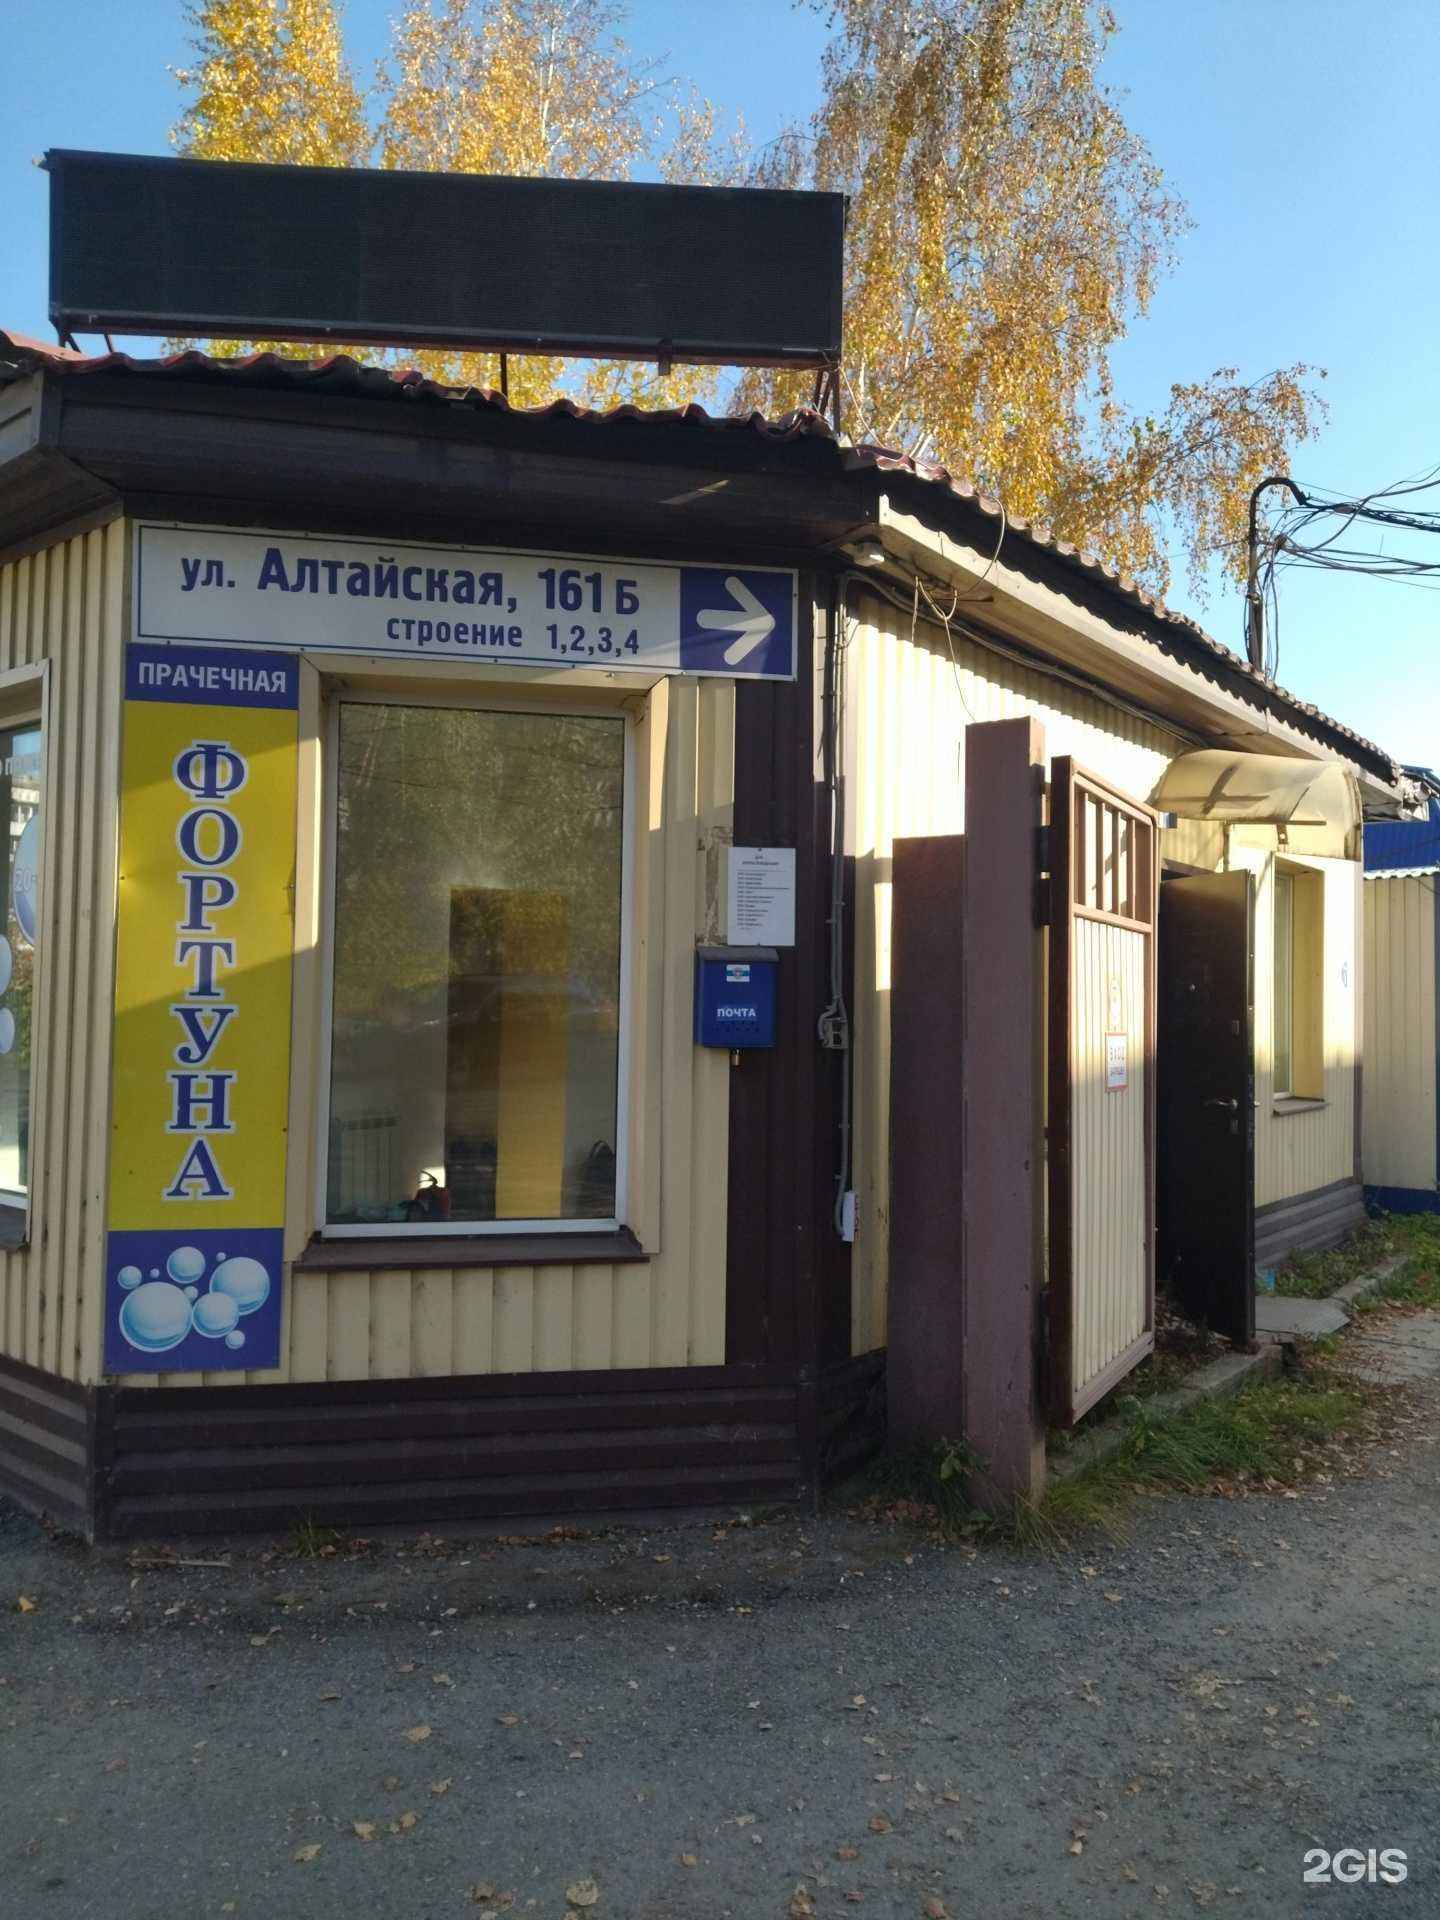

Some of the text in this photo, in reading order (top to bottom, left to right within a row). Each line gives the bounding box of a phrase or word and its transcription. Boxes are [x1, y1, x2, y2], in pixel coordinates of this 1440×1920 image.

[181, 547, 640, 615] ул. Алтайская, 161 Б
[387, 617, 523, 647] строение
[138, 661, 287, 694] ПРАЧЕЧНАЯ
[164, 742, 248, 1200] ФОРТУНА
[716, 1007, 756, 1018] ПОЧТА
